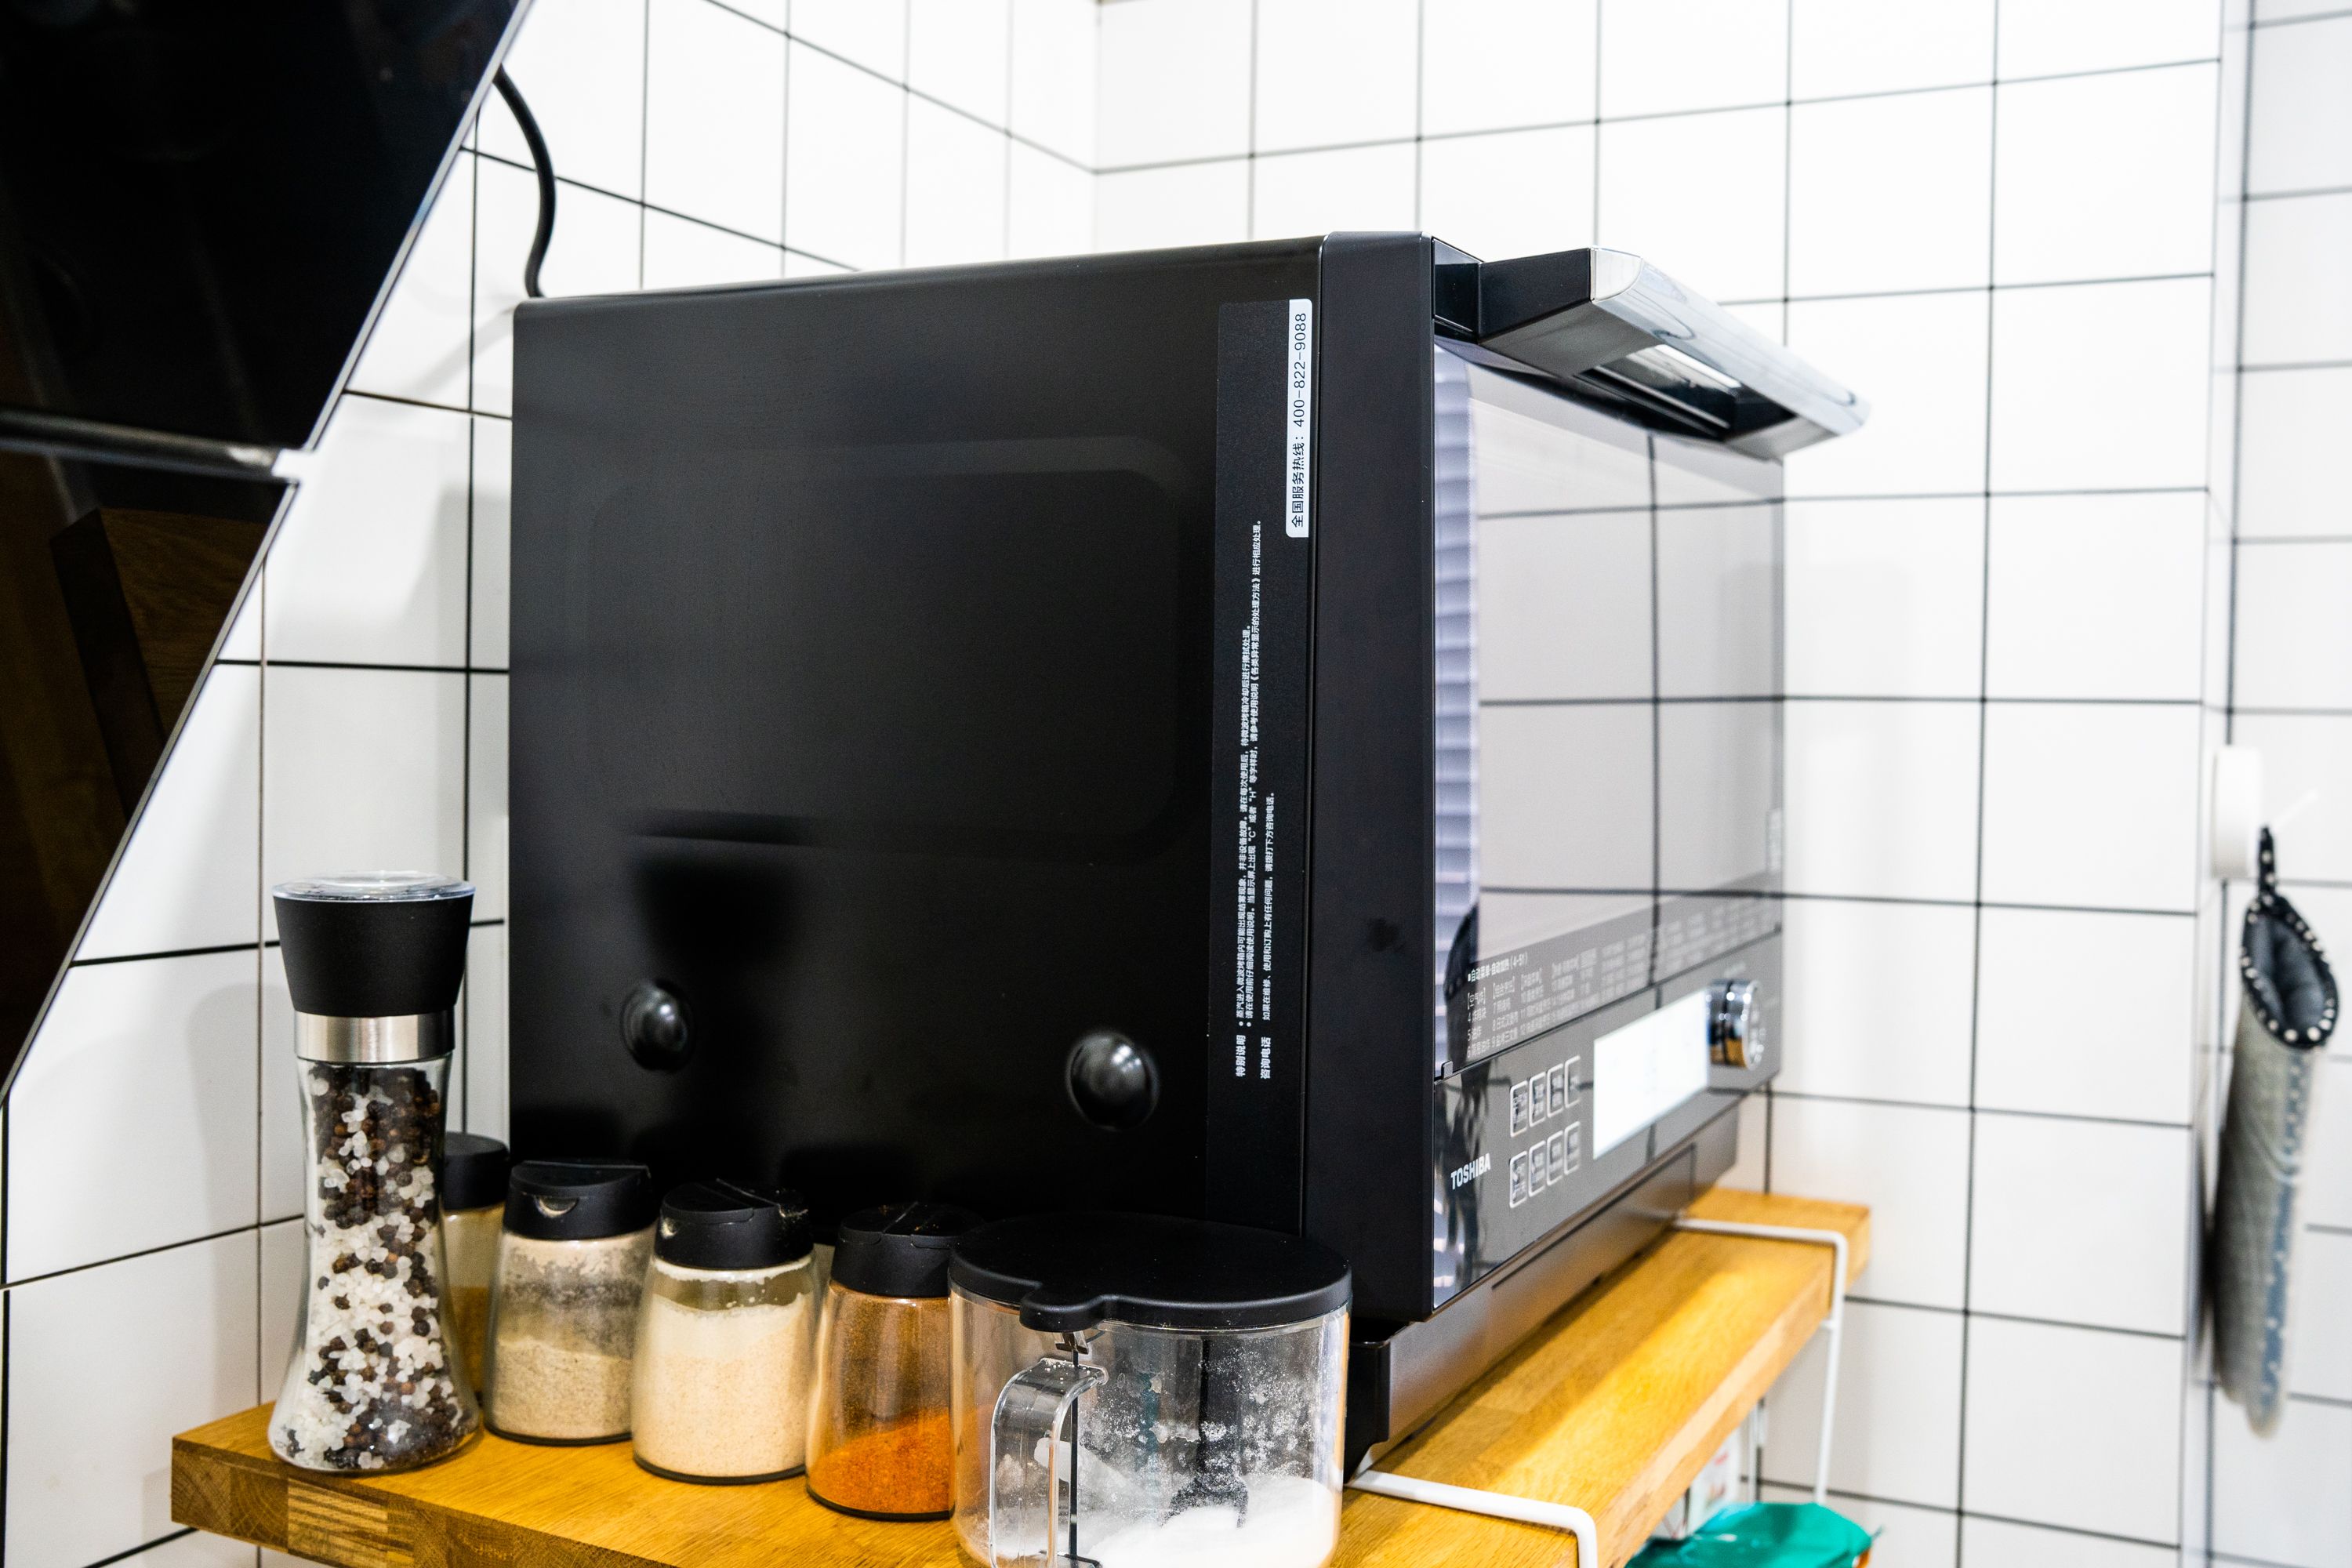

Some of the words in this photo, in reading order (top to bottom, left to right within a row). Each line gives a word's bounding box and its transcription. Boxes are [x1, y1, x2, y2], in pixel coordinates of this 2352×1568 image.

[1293, 313, 1306, 427] 400-822-9088
[1235, 1034, 1247, 1077] 特别说明
[1261, 1036, 1272, 1080] 咨询电话
[1450, 1152, 1491, 1190] TOSHIBA
